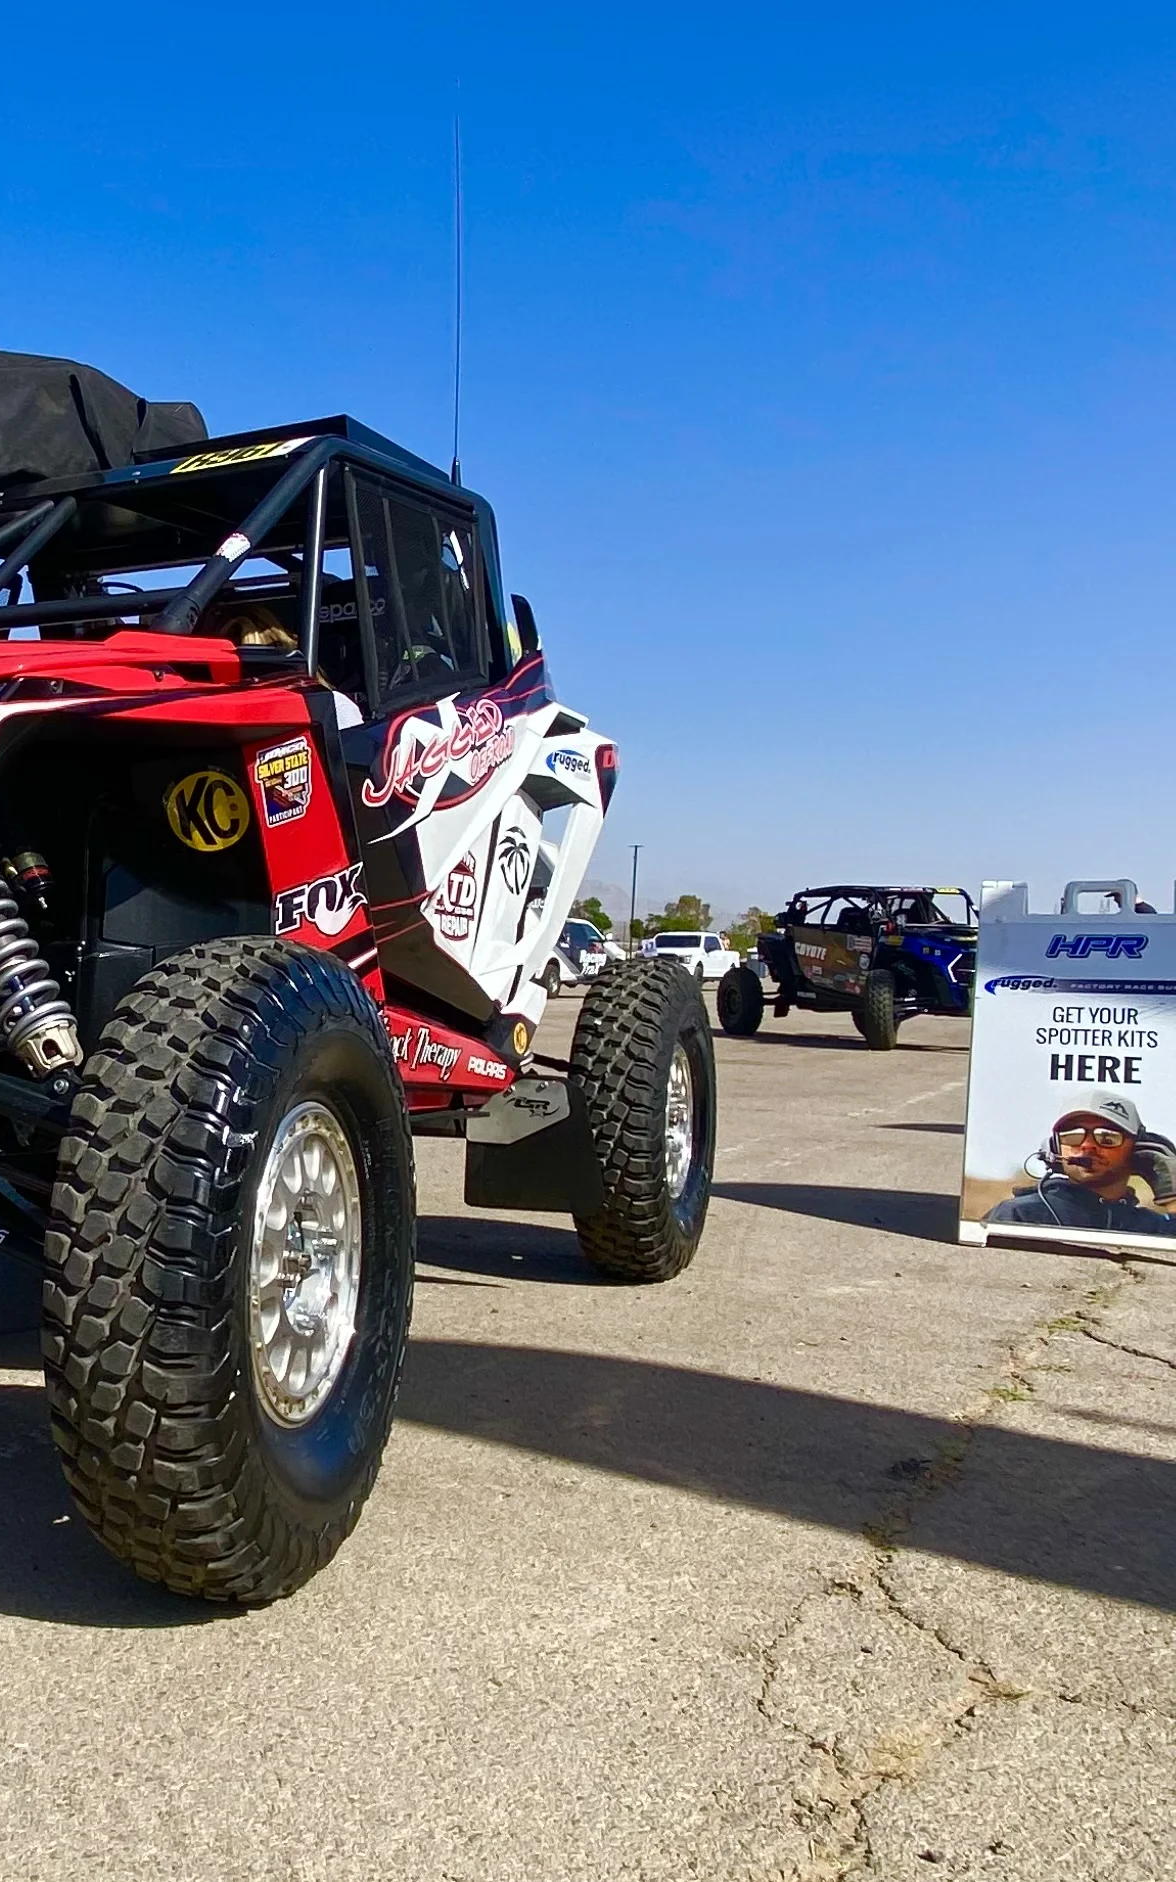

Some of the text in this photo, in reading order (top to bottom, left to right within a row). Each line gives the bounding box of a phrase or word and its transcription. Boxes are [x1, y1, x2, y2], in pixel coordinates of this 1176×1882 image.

[319, 598, 386, 623] spaco
[258, 759, 284, 779] SILVER
[285, 751, 308, 770] STATE
[362, 699, 504, 807] JAGGED
[284, 765, 308, 789] 300
[269, 805, 304, 824] PARTICIPANT
[275, 862, 367, 935] FOX
[794, 942, 827, 961] COYOTE
[1045, 934, 1149, 959] HPR
[1052, 1006, 1139, 1025] GET YOUR
[1035, 1027, 1159, 1048] SPOTTER KITS
[411, 1027, 461, 1081] Therapy
[467, 1056, 507, 1080] POLARIS
[1049, 1053, 1143, 1085] HERE
